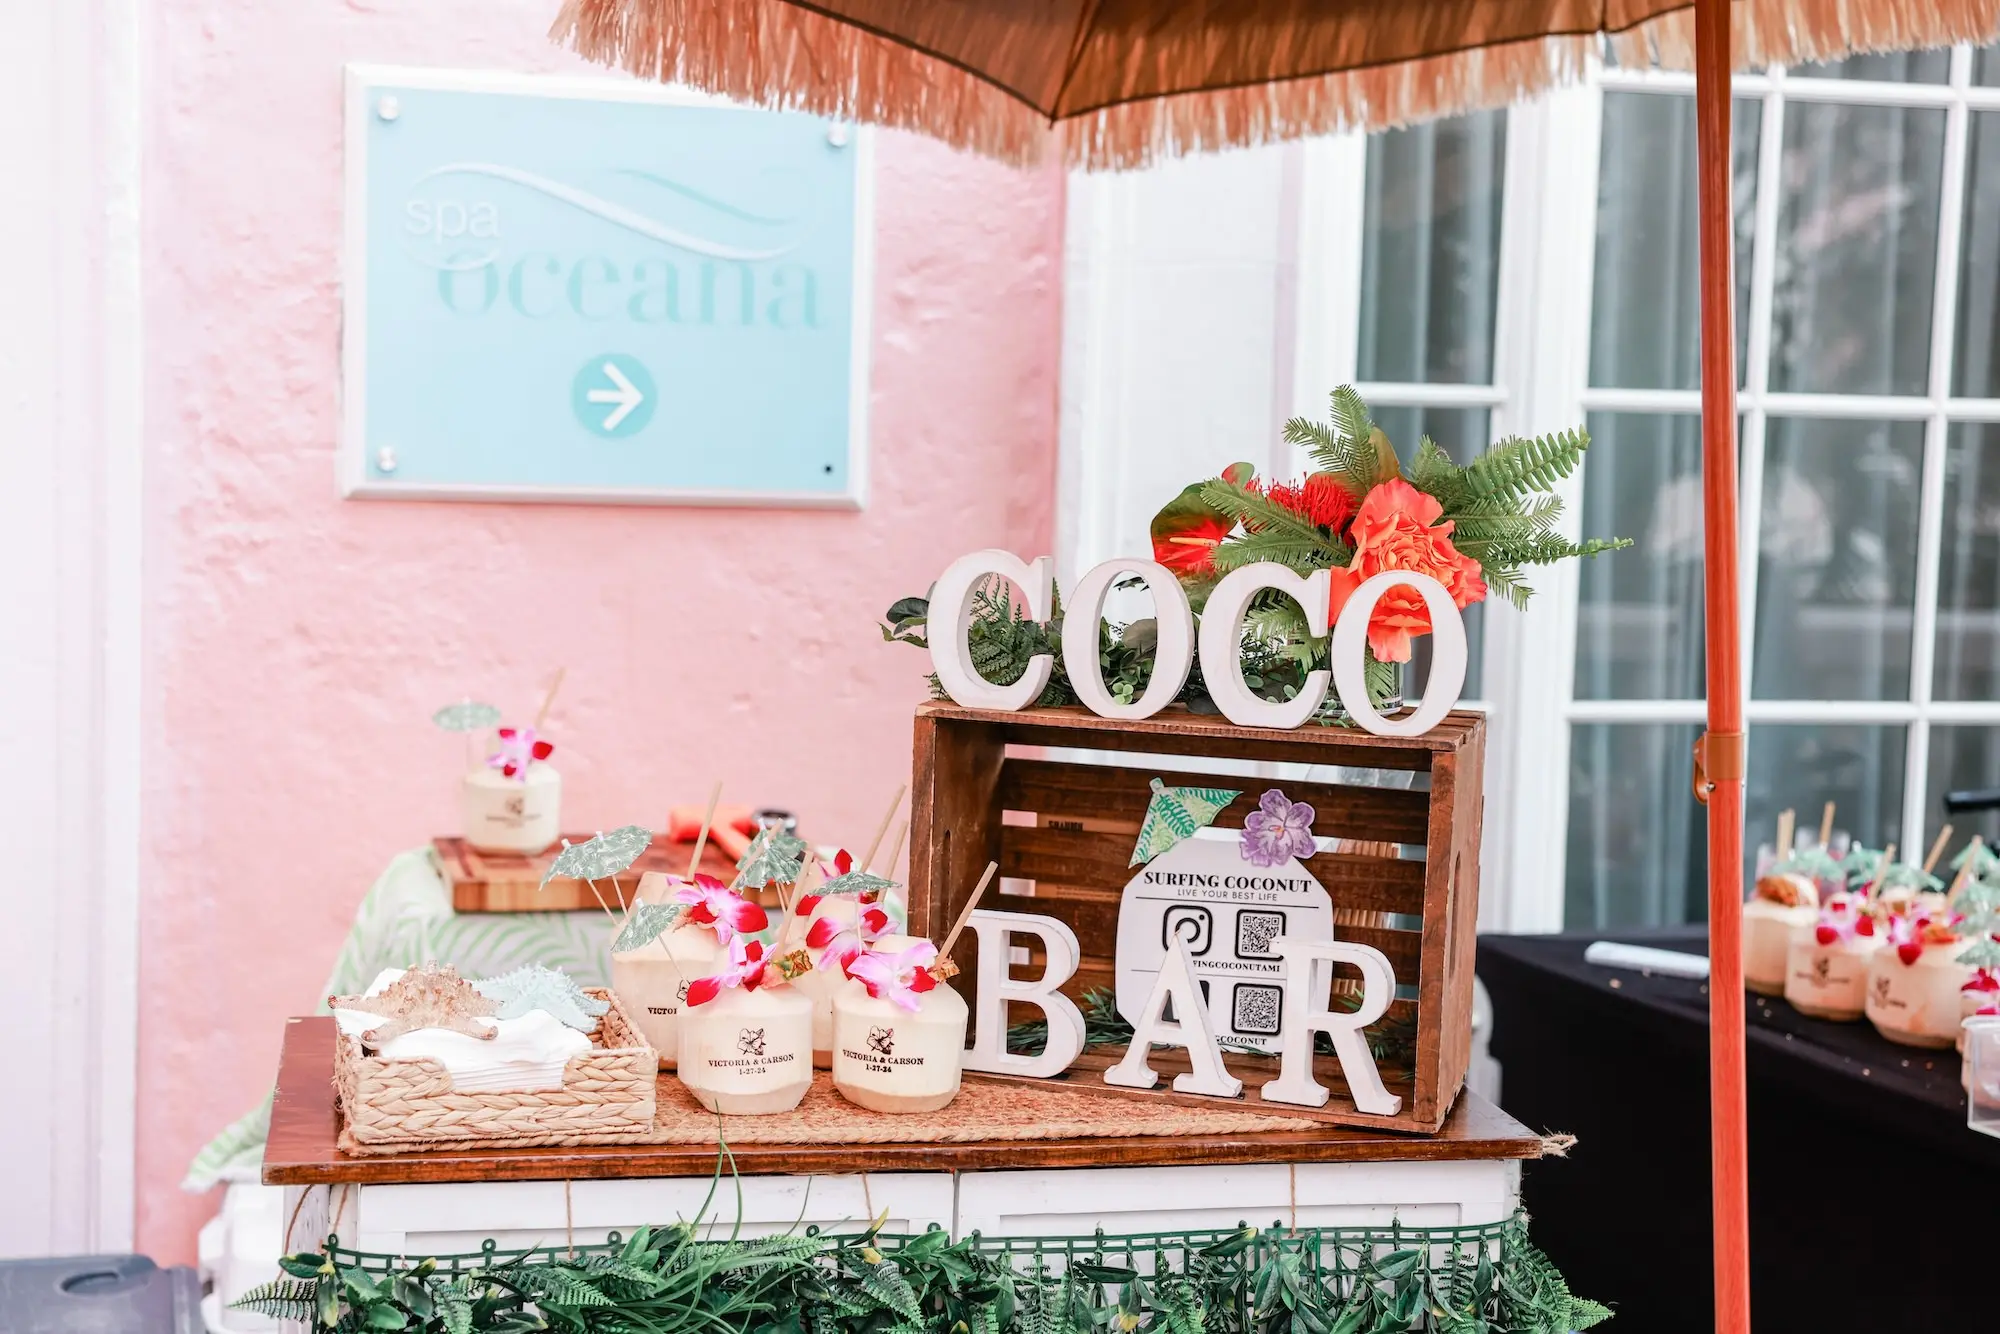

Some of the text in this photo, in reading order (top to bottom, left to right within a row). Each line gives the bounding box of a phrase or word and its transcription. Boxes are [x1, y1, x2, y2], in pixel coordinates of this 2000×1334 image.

[404, 198, 500, 245] spa
[437, 247, 828, 330] oceana
[926, 548, 1468, 737] COCO
[1143, 871, 1312, 893] SURFING COCONUT
[1177, 888, 1278, 901] LIVE YOUR BEST LIFE
[963, 908, 1402, 1116] BAR
[708, 1058, 750, 1067] VICTORIA
[761, 1053, 794, 1065] CARSON
[842, 1049, 924, 1065] VICTORIA & CARSON
